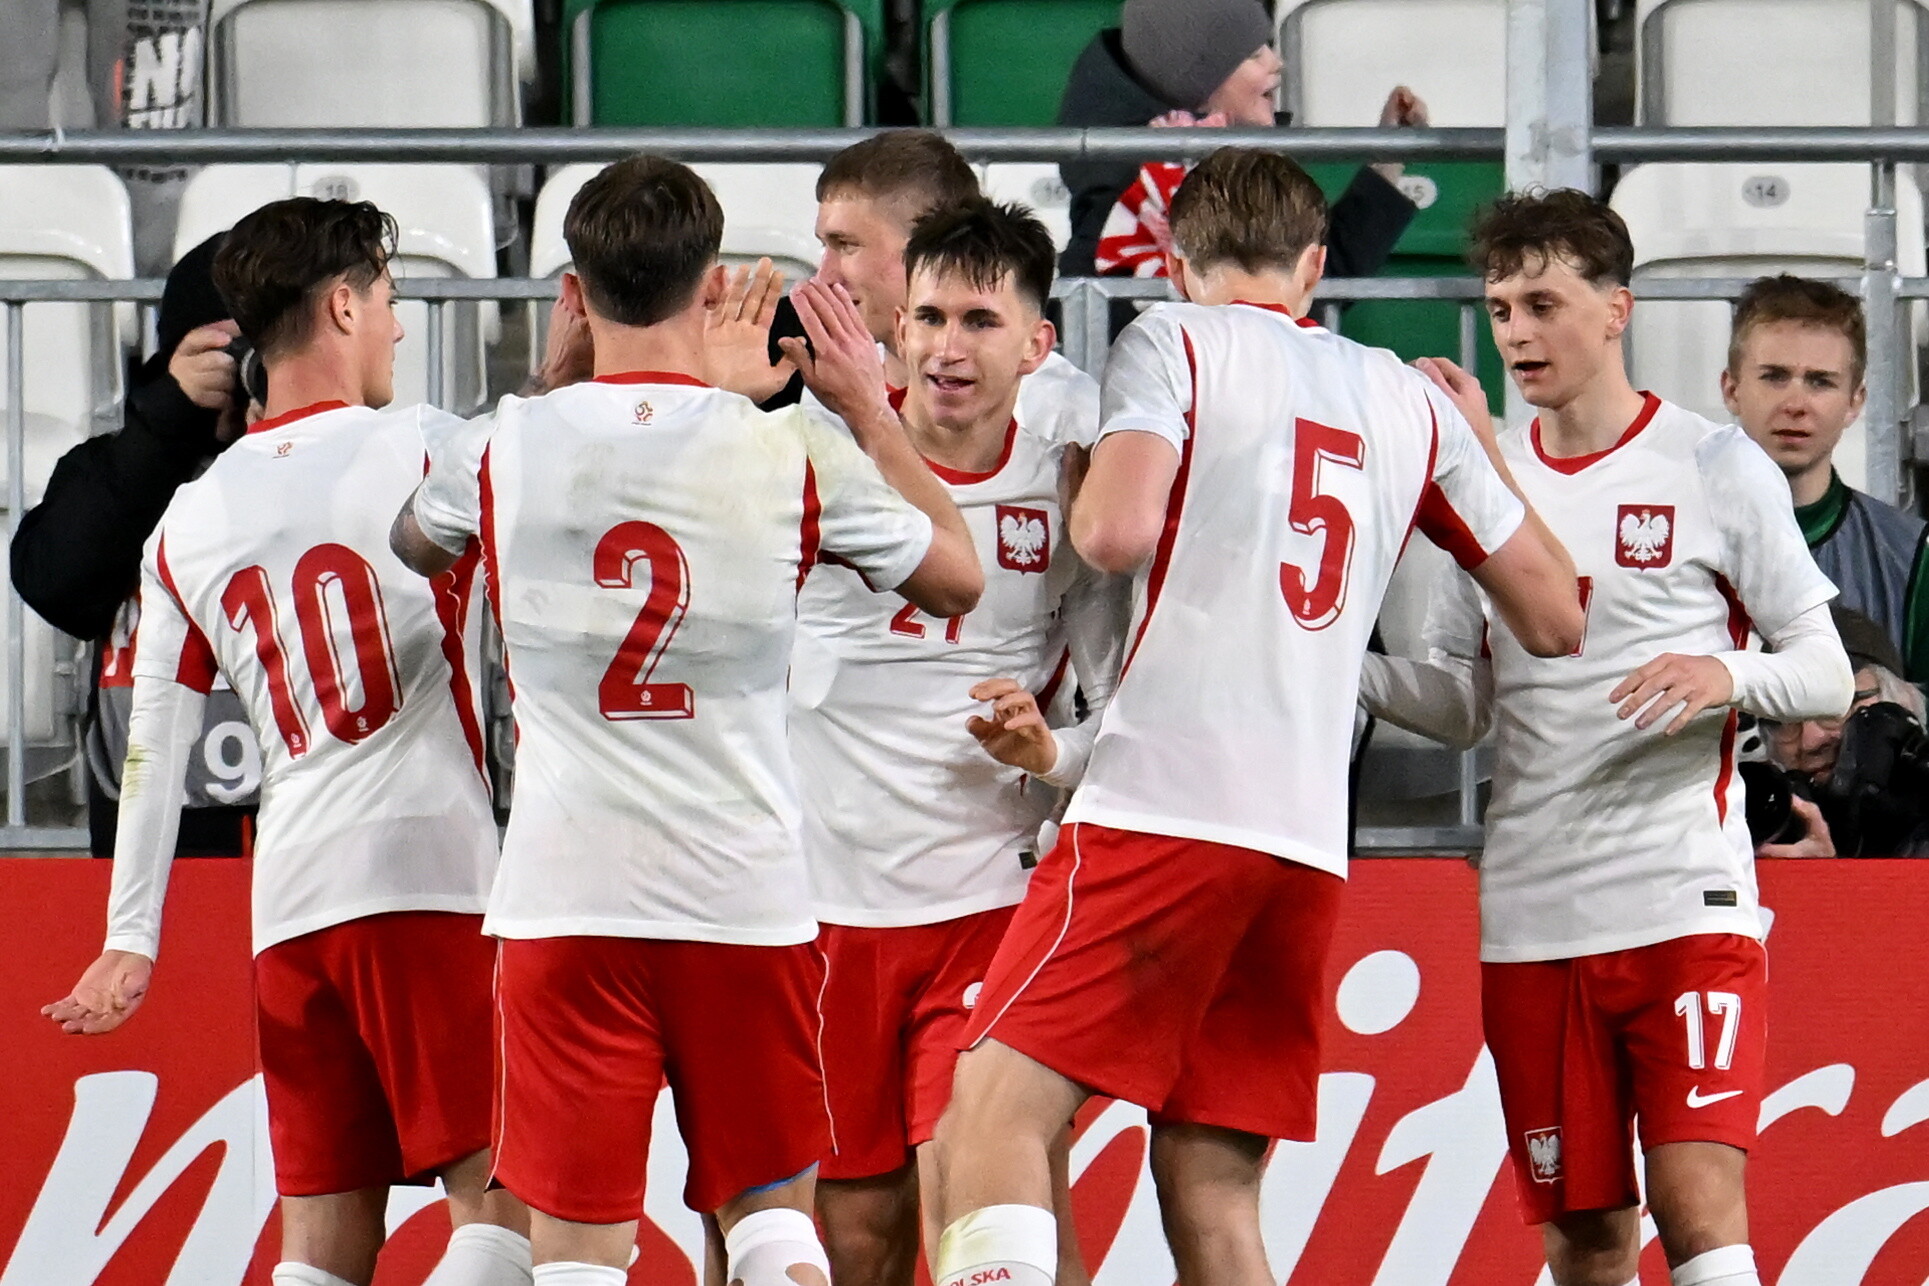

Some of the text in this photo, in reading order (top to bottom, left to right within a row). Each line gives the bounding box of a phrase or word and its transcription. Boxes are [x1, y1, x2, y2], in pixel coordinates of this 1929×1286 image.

[1755, 183, 1776, 200] 14
[593, 520, 695, 721] 2
[1279, 417, 1366, 632] 5
[219, 542, 404, 761] 10
[1673, 990, 1742, 1071] 17
